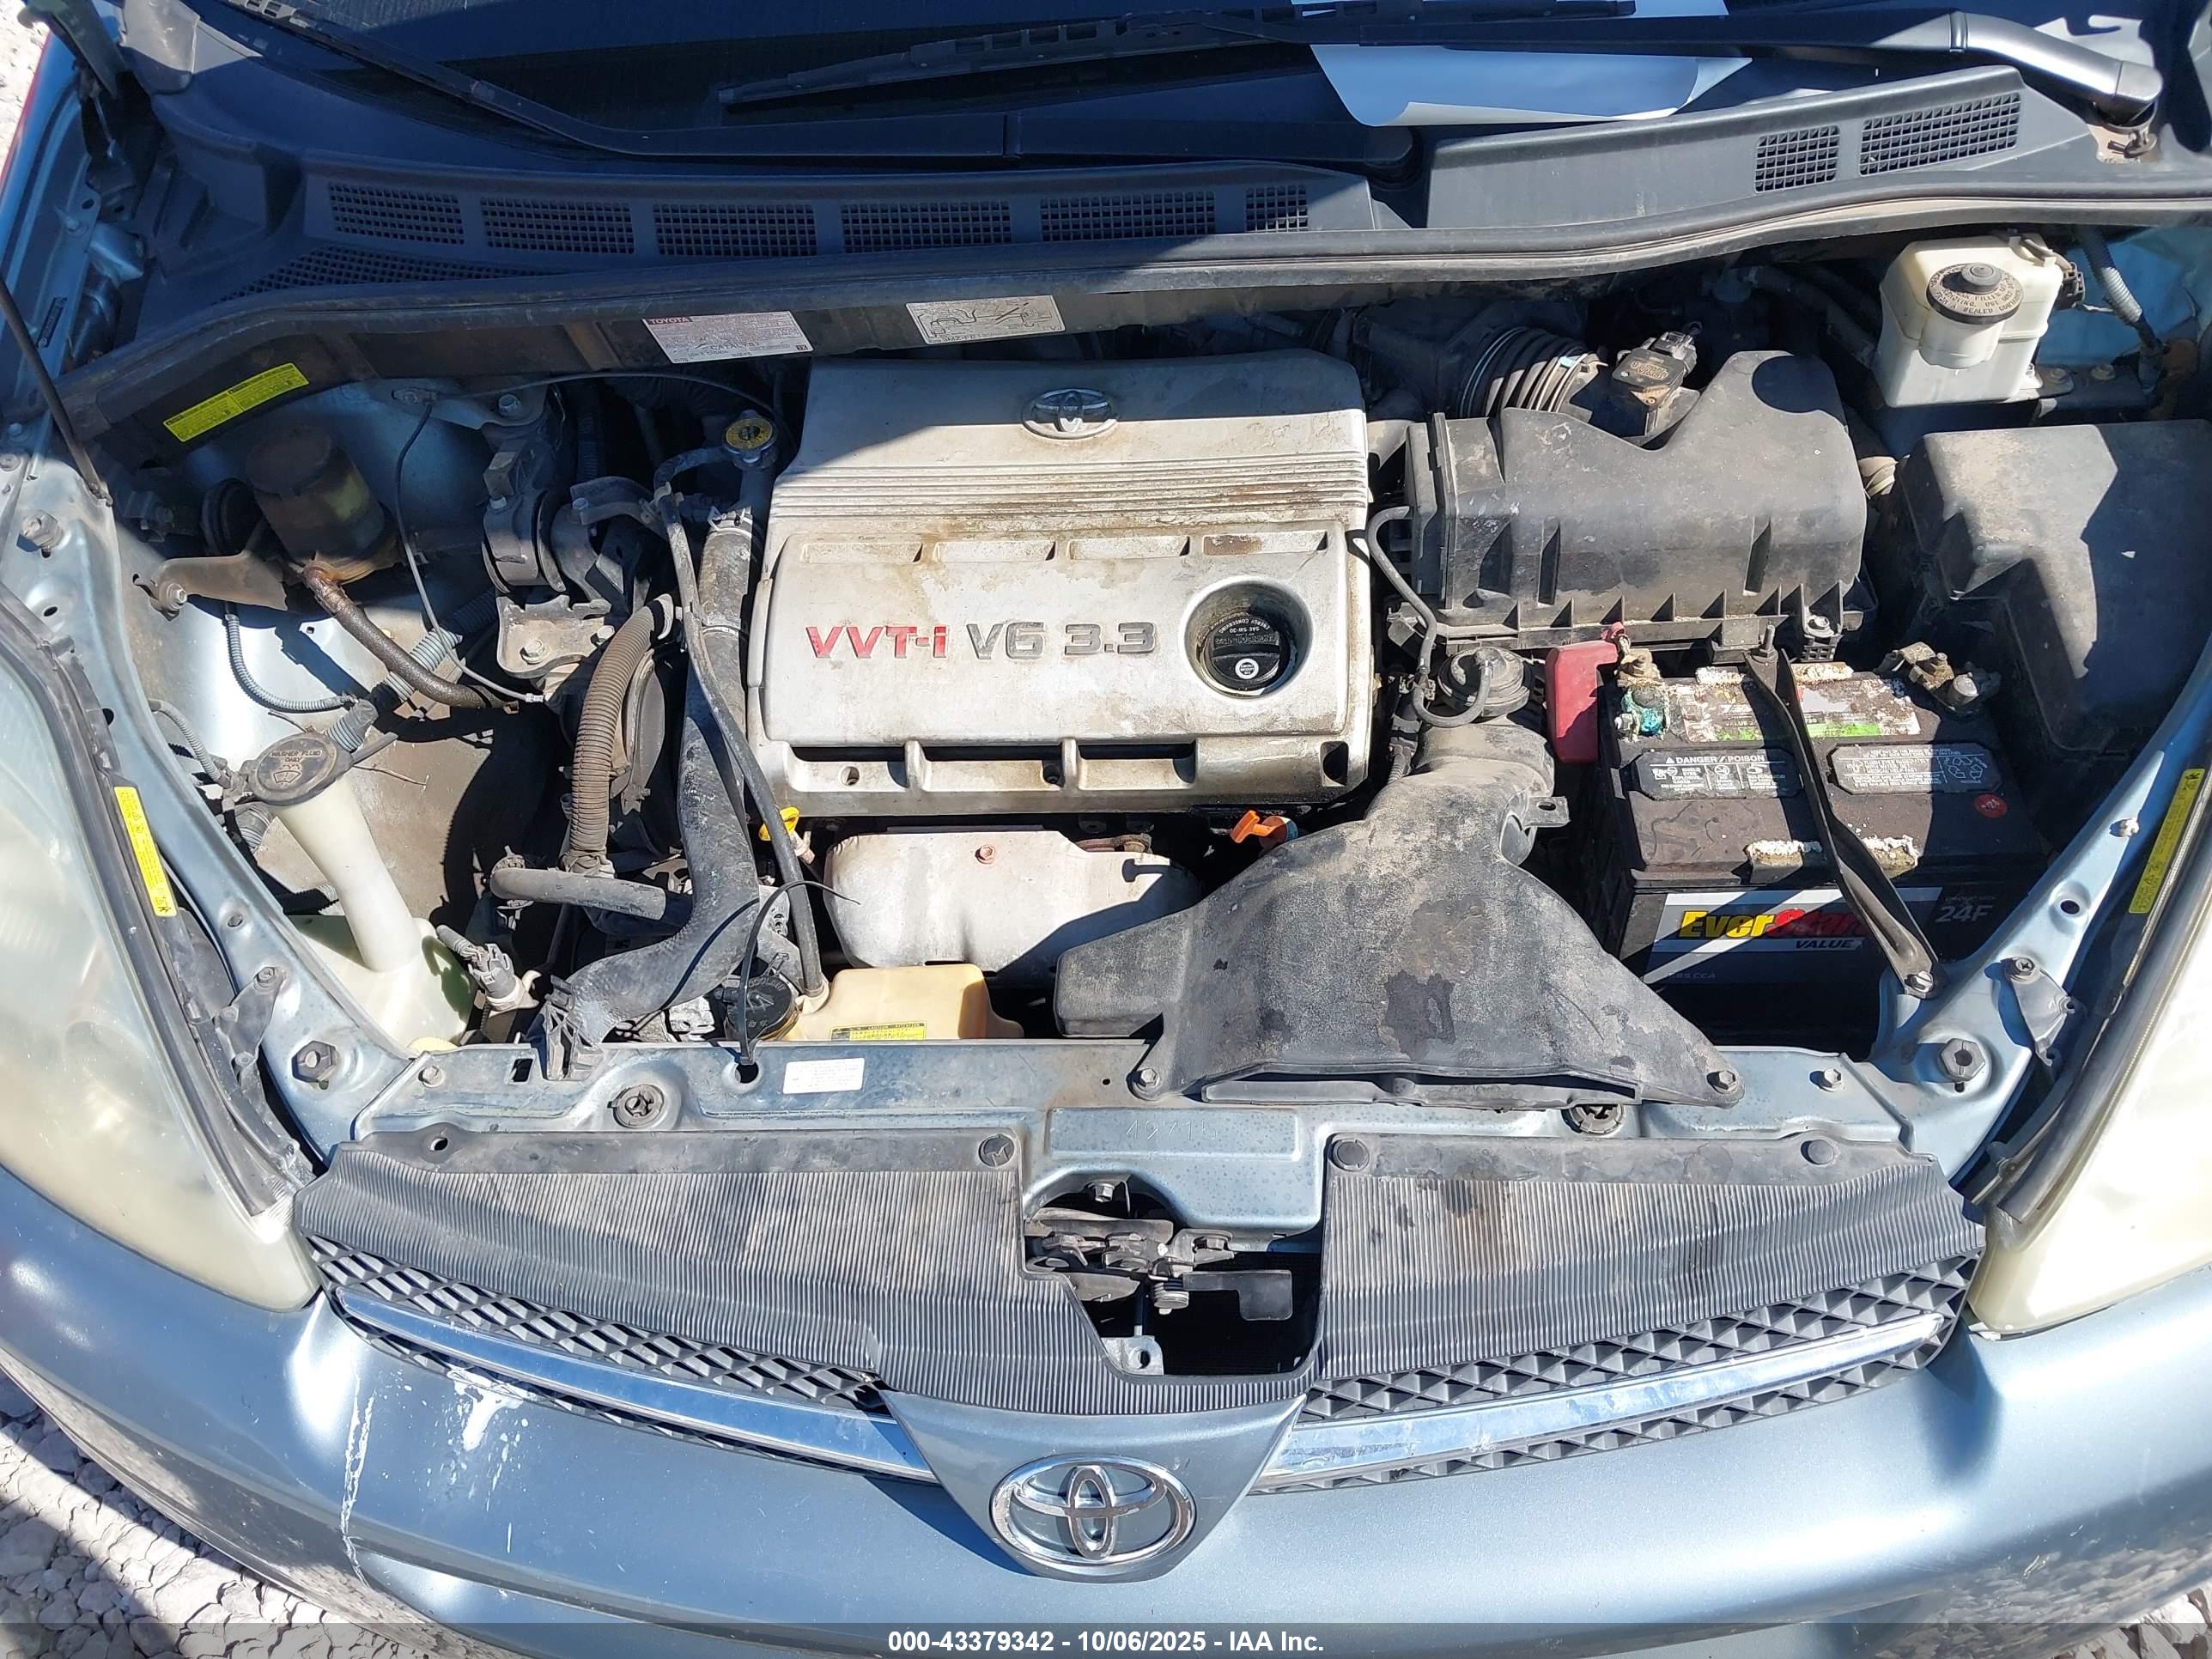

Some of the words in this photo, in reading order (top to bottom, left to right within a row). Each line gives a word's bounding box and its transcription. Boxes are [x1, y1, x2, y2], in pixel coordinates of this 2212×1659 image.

[651, 316, 690, 325] TOYOTA
[805, 624, 948, 659] VVT-i
[966, 622, 1047, 659] V6
[1064, 622, 1158, 656] 3.3
[1934, 904, 1993, 923] 24F
[1796, 939, 1855, 949] VALUE
